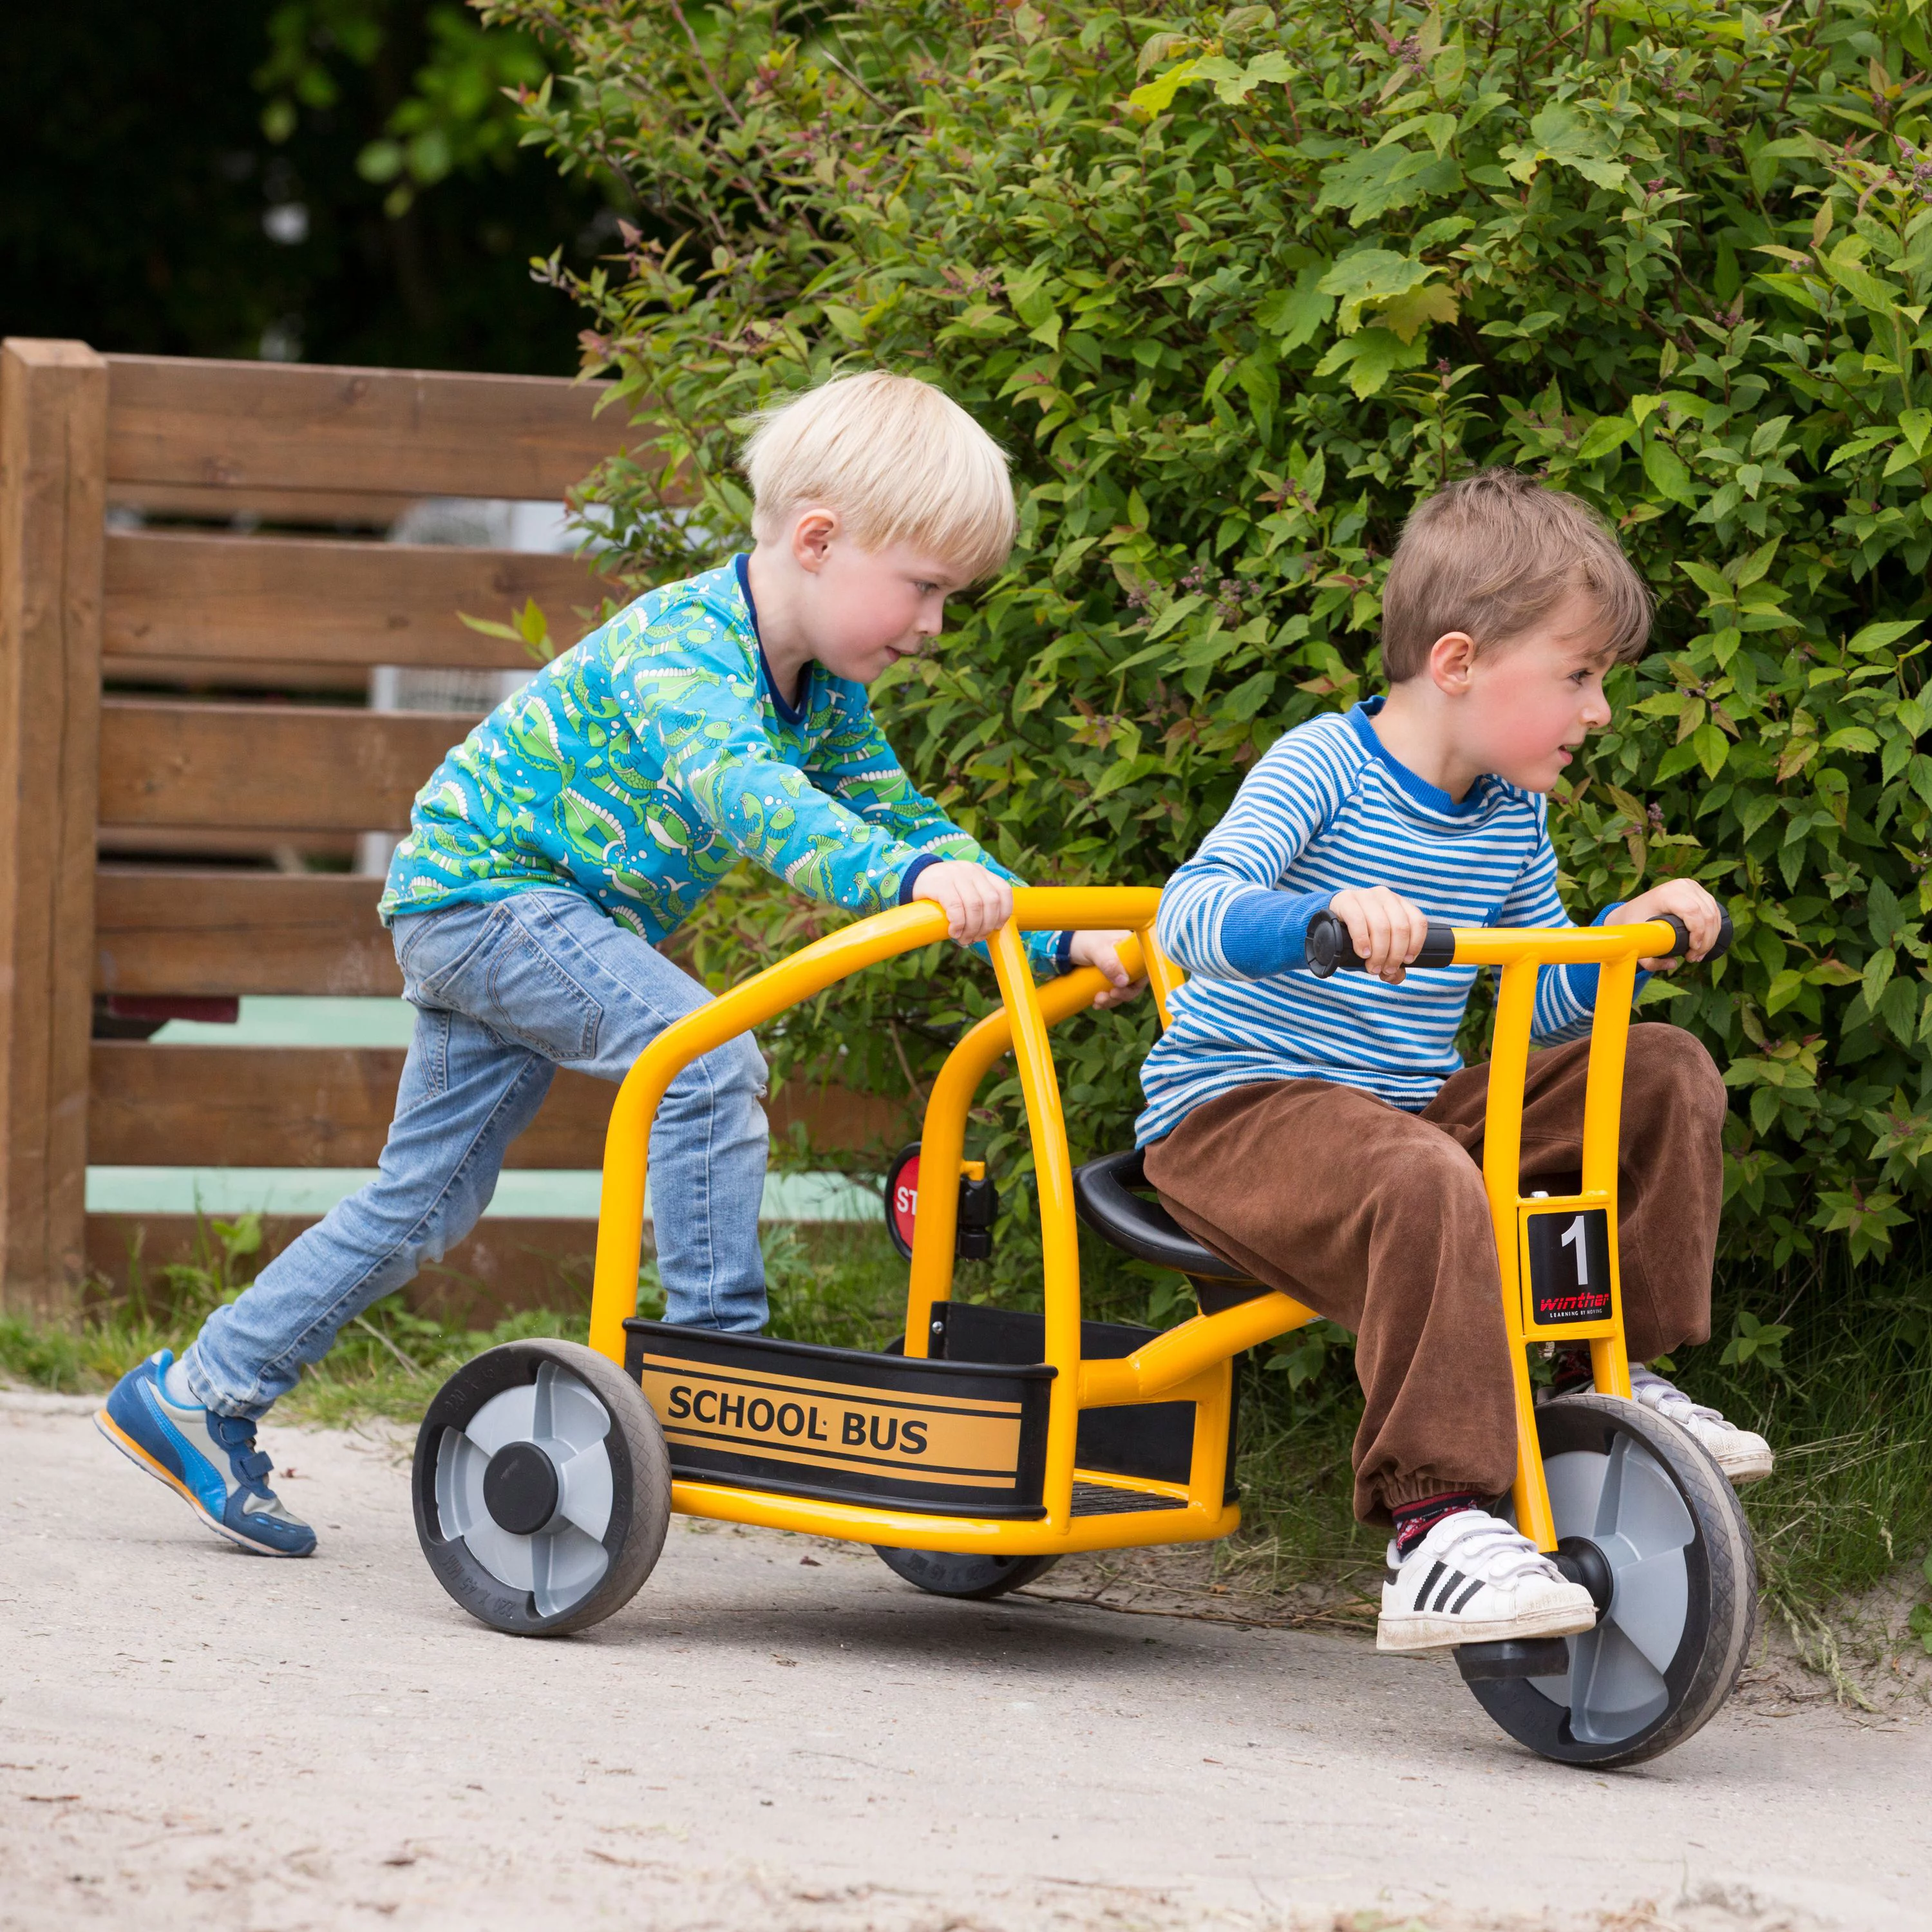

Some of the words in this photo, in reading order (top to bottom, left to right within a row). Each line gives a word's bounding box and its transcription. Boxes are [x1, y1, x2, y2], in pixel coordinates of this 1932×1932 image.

[896, 1186, 918, 1216] ST
[1561, 1215, 1588, 1285] 1
[667, 1385, 828, 1442] SCHOOL
[841, 1412, 928, 1455] BUS
